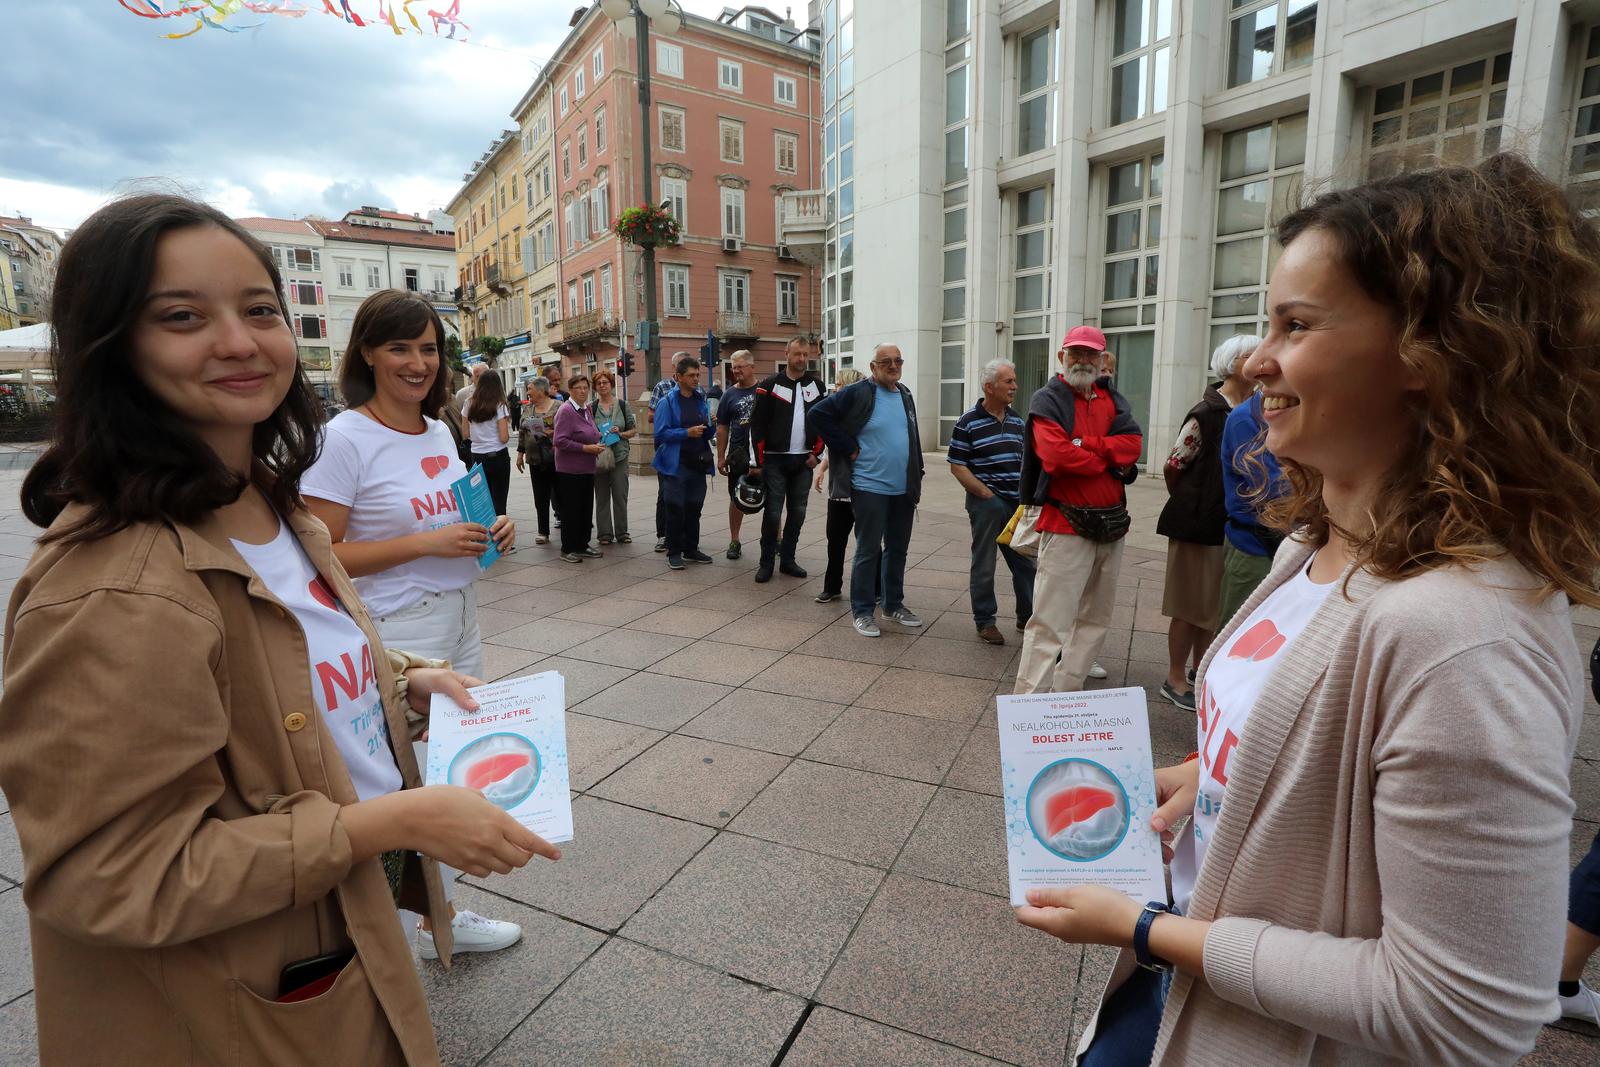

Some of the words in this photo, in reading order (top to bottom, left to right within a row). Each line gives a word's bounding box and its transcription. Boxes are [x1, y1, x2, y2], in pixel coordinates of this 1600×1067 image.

[515, 694, 547, 707] MASNA
[460, 714, 499, 727] BOLEST
[500, 707, 532, 720] JETRE
[1012, 719, 1092, 732] NEALKOHOLNA
[1093, 717, 1132, 728] MASNA
[1032, 733, 1075, 744] BOLEST
[1078, 731, 1114, 742] JETRE
